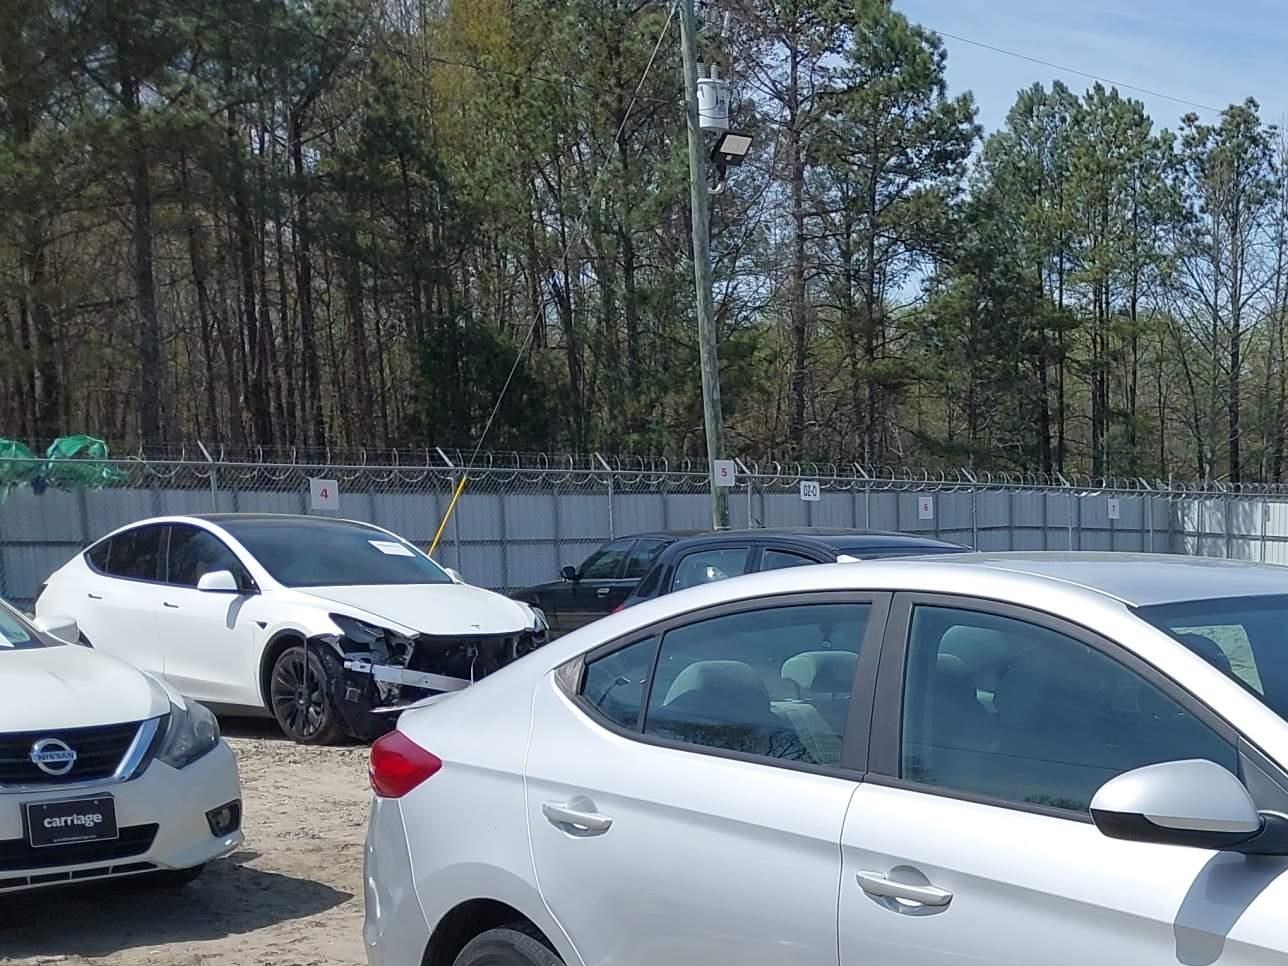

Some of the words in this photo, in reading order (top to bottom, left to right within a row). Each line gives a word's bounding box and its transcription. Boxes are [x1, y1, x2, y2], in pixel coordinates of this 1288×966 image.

[721, 467, 728, 477] 5
[320, 488, 329, 500] 4
[37, 751, 74, 762] NISSAN
[43, 813, 103, 829] carriage
